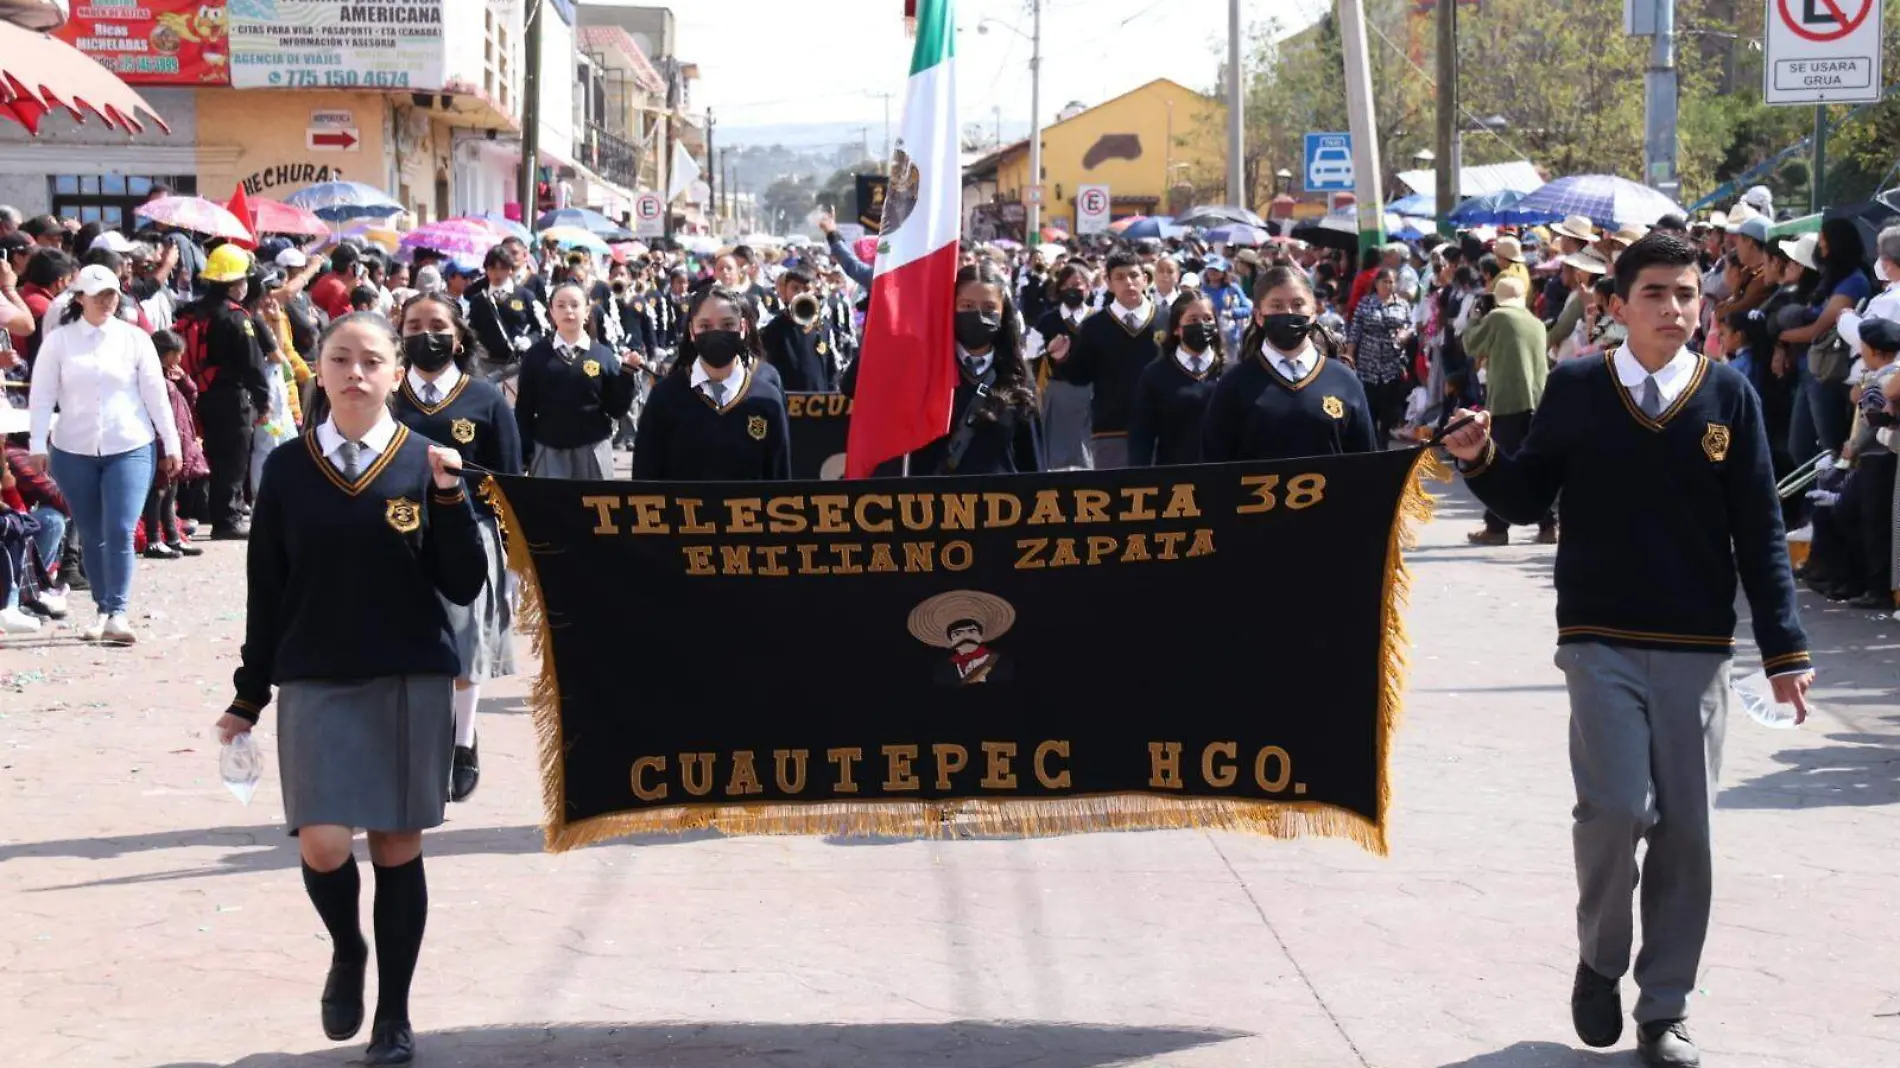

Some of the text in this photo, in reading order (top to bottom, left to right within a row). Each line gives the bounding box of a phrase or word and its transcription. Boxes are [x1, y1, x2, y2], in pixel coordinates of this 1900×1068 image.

[340, 6, 441, 23] AMERICANA
[238, 25, 264, 34] CITAS
[266, 25, 290, 34] PARA
[233, 53, 284, 65] AGENCIA
[286, 53, 300, 65] DE
[303, 54, 342, 65] VIAJES
[1789, 63, 1806, 73] SE
[286, 69, 409, 88] 775 150 4674
[643, 200, 654, 216] E
[582, 473, 1327, 535] TELESECUNDARIA 38
[683, 529, 1217, 576] EMILIANO ZAPATA
[630, 740, 1307, 801] CUAUTEPEC HGO.
